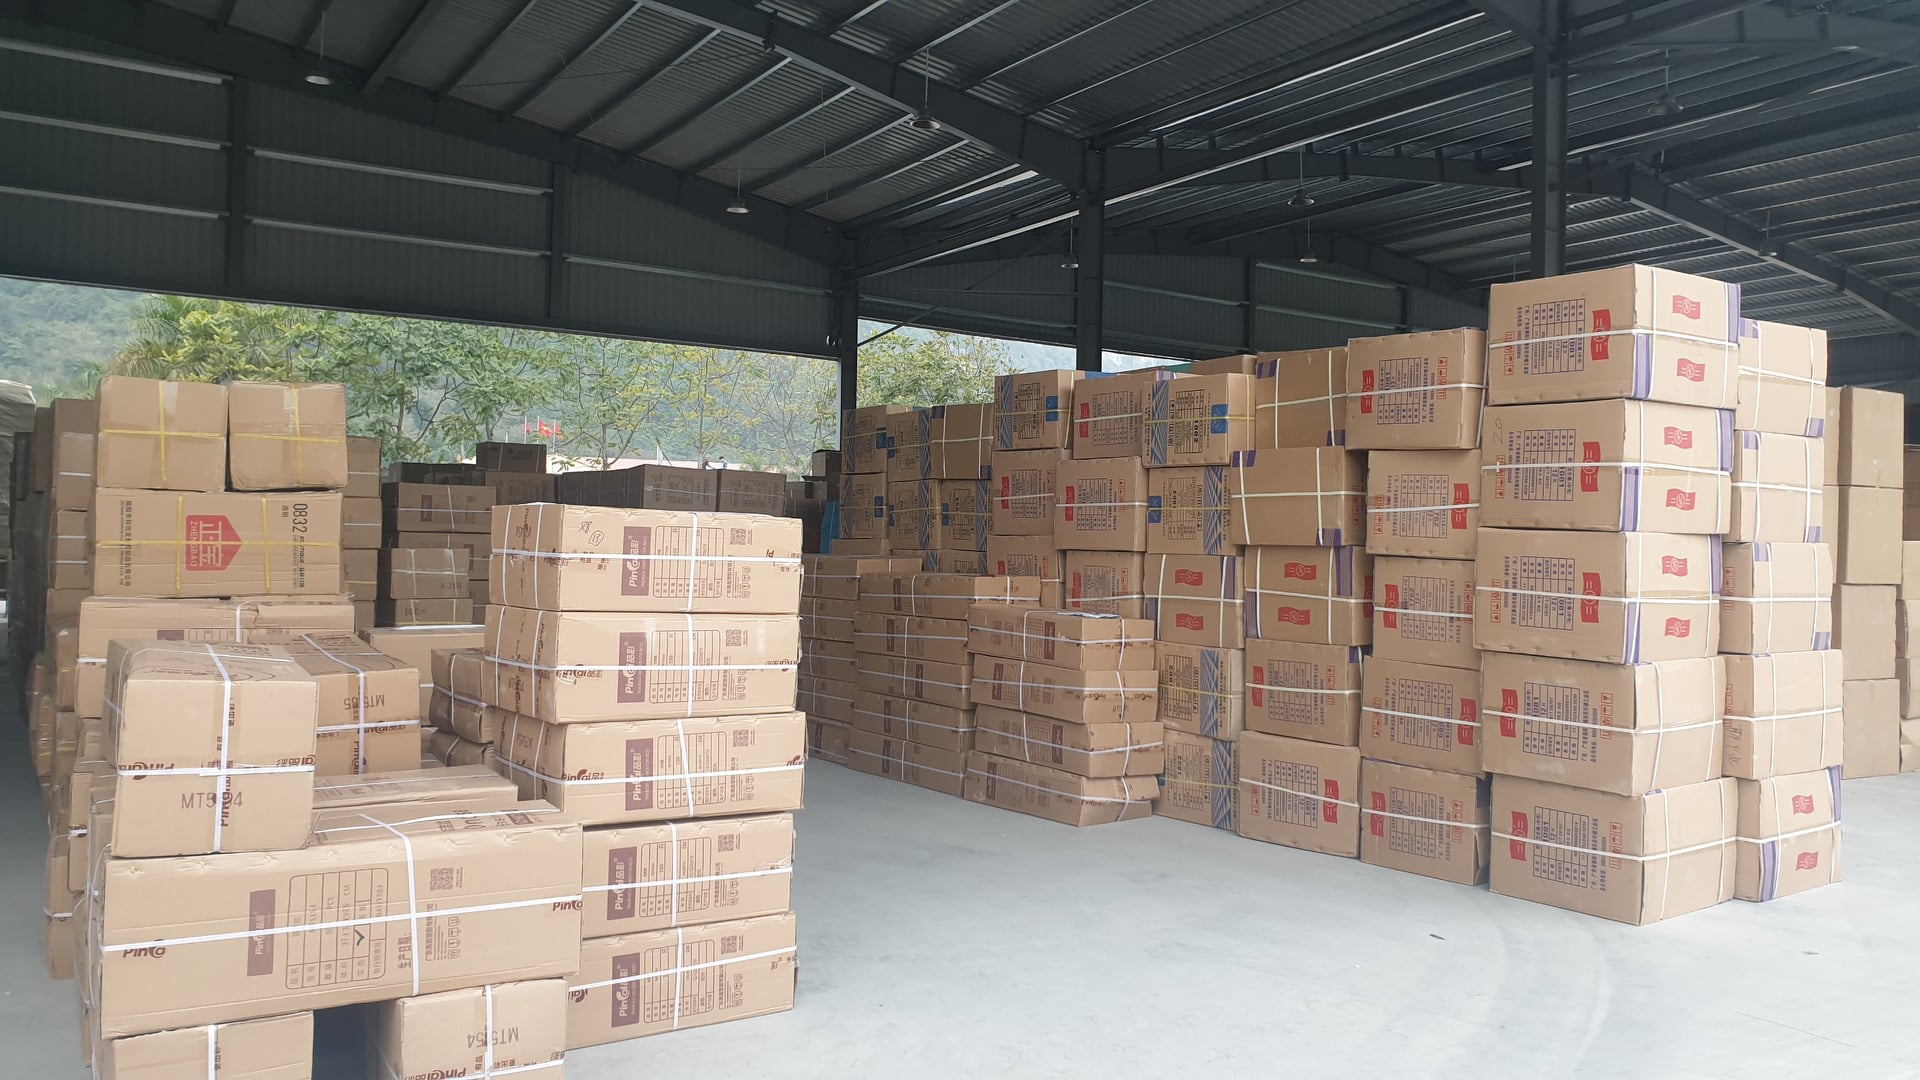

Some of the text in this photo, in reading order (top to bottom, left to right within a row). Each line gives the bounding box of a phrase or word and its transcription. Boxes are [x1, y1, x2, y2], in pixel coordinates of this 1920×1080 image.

[292, 503, 309, 533] 0832
[626, 558, 641, 588] PinCa
[343, 691, 385, 711] MT565
[181, 791, 243, 809] MT594
